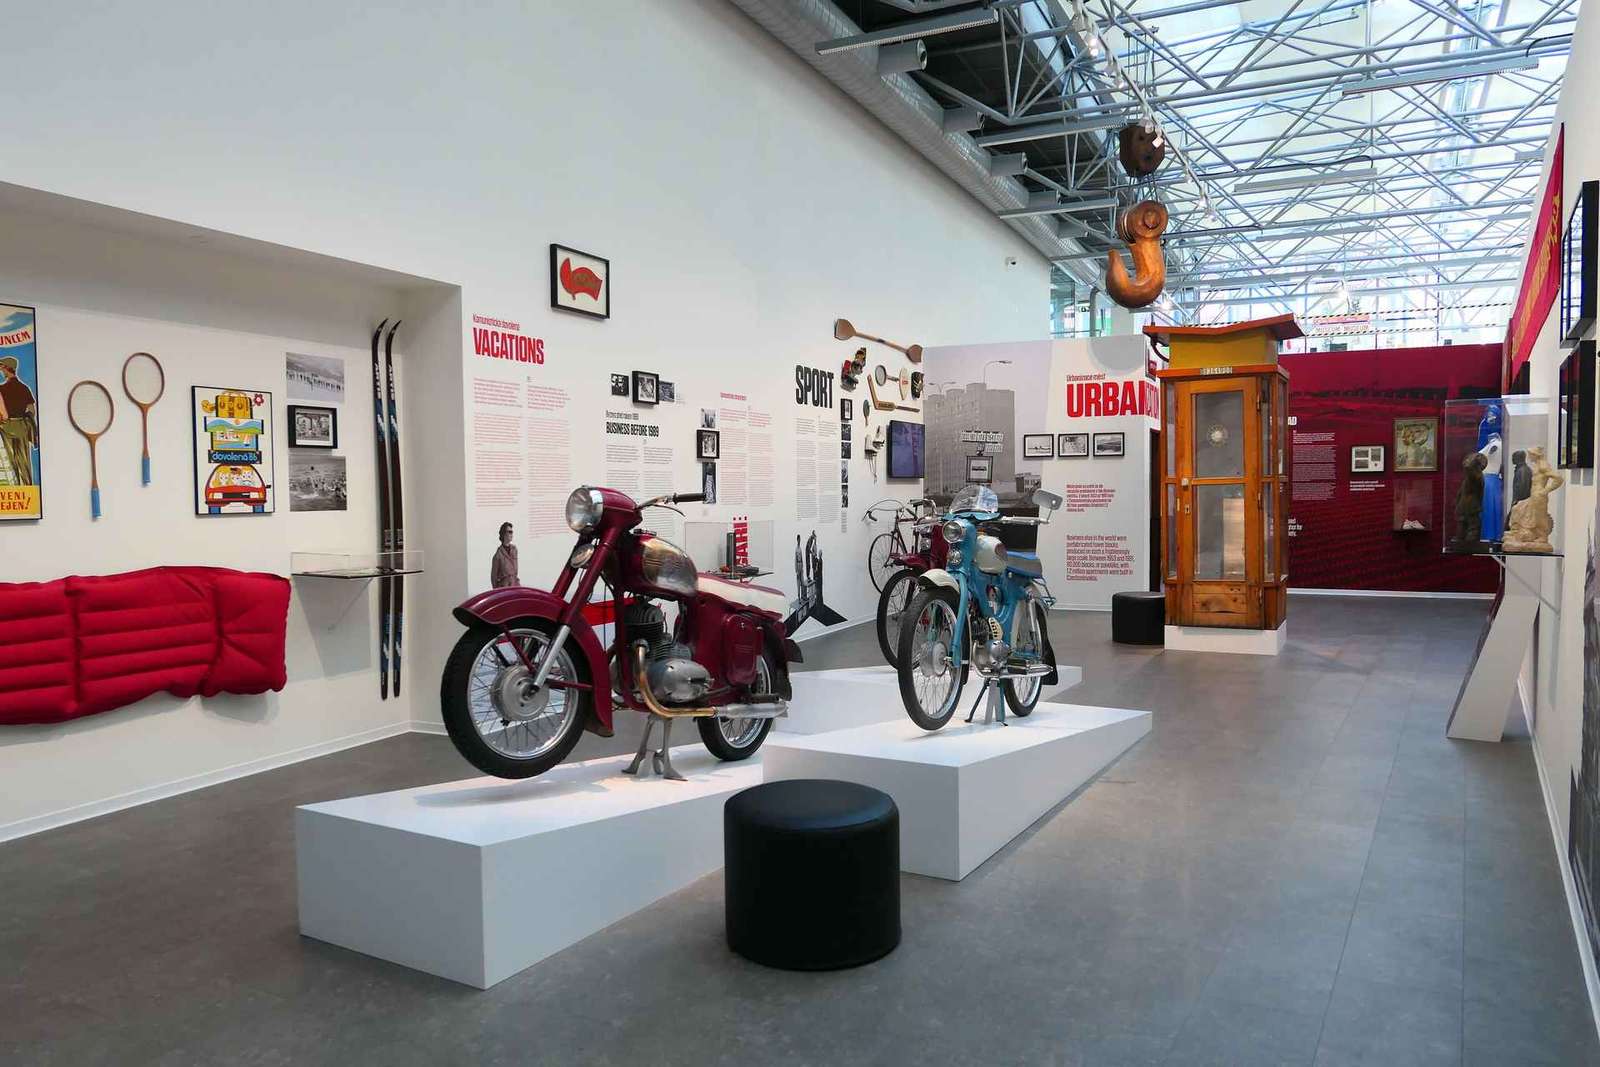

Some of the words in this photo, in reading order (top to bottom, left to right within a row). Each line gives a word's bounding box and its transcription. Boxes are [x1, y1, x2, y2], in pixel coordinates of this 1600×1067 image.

[473, 327, 545, 365] VACATIONS
[795, 364, 835, 409] SPORT
[606, 421, 630, 435] BUSINESS
[630, 423, 648, 436] BEFORE
